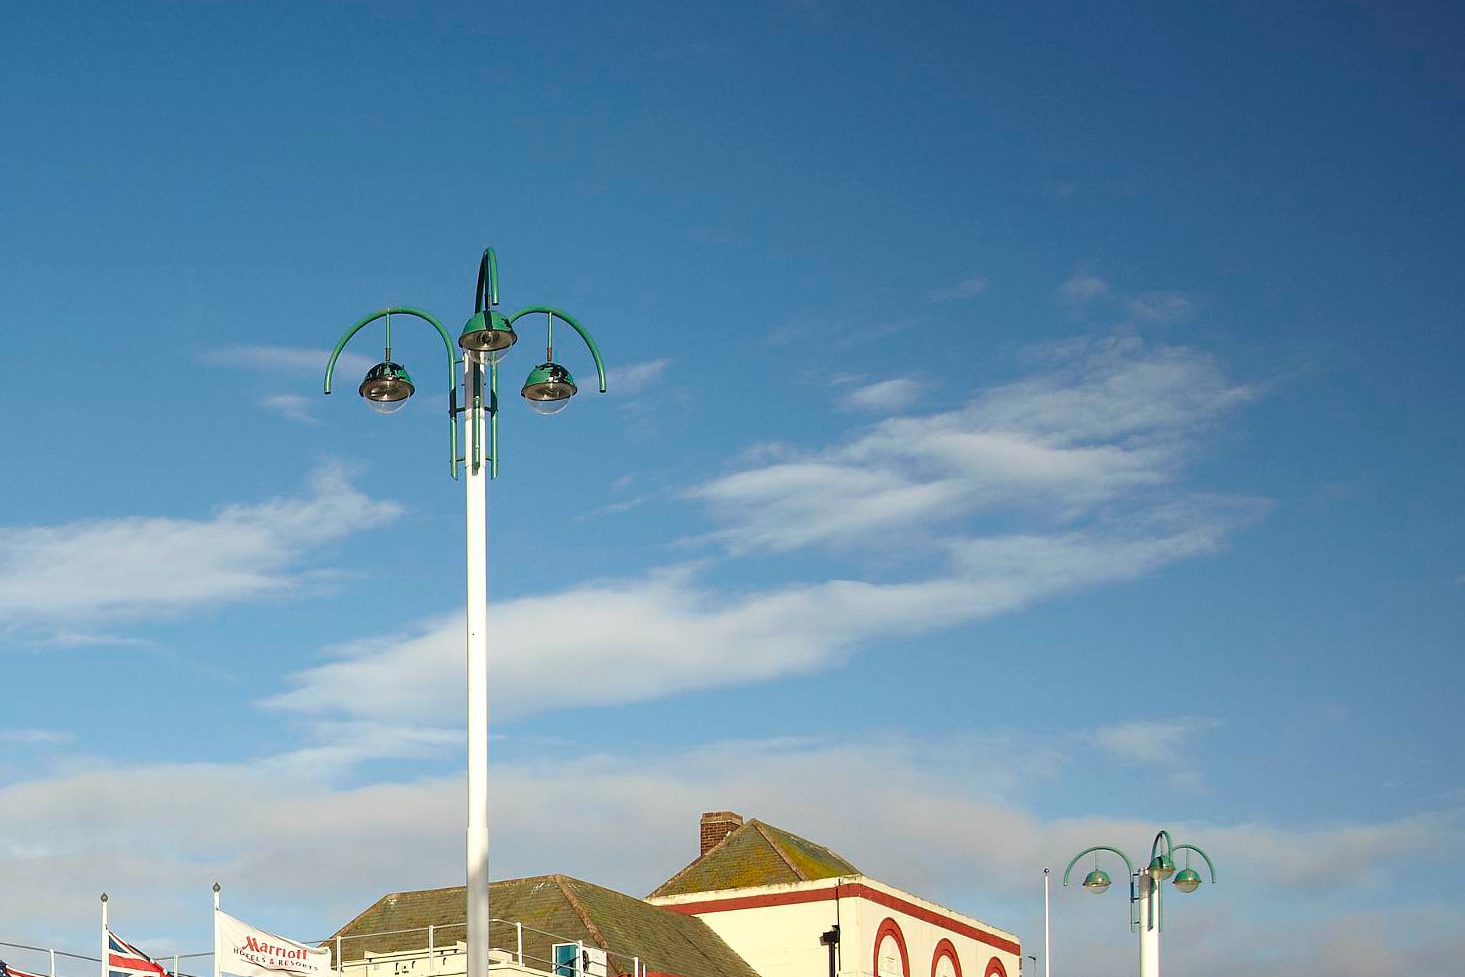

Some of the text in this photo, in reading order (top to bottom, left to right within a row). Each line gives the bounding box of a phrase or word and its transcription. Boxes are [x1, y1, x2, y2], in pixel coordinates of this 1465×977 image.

[233, 947, 266, 963] HOTELS
[278, 959, 319, 971] RESORTS
[241, 935, 307, 961] Marriott
